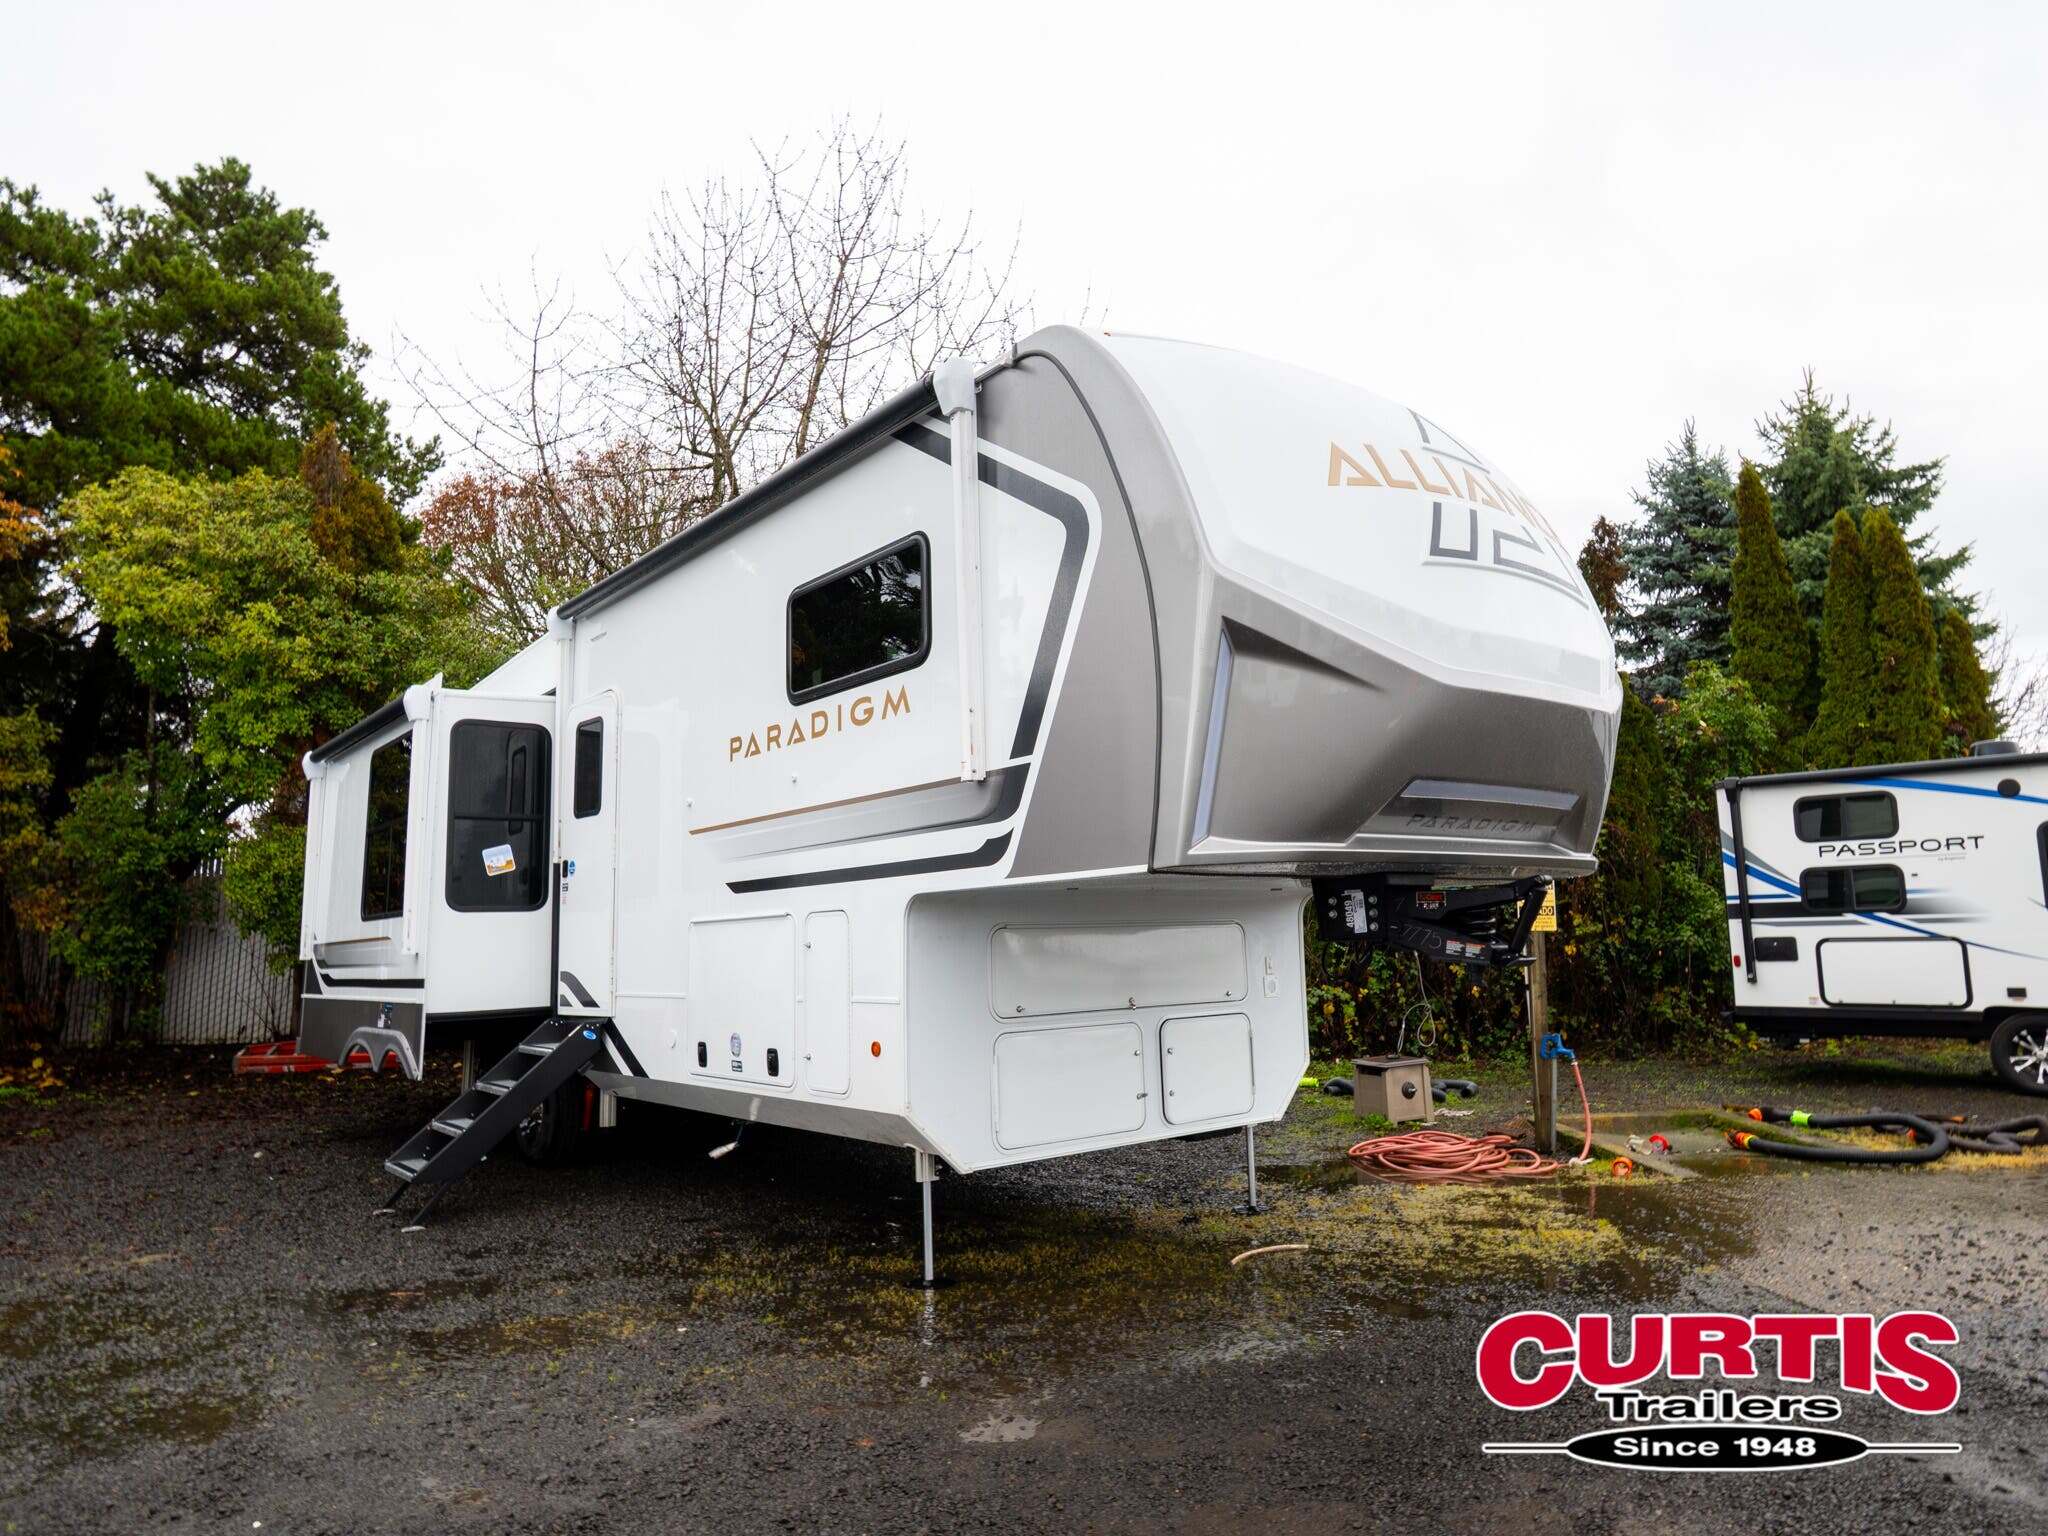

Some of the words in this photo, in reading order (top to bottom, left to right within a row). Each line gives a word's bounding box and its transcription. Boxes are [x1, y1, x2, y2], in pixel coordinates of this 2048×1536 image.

[1328, 441, 1563, 548] ALLIAN
[730, 685, 911, 762] PARADIGM
[1406, 814, 1537, 833] PARADIGM
[1818, 835, 1985, 858] PASSPORT
